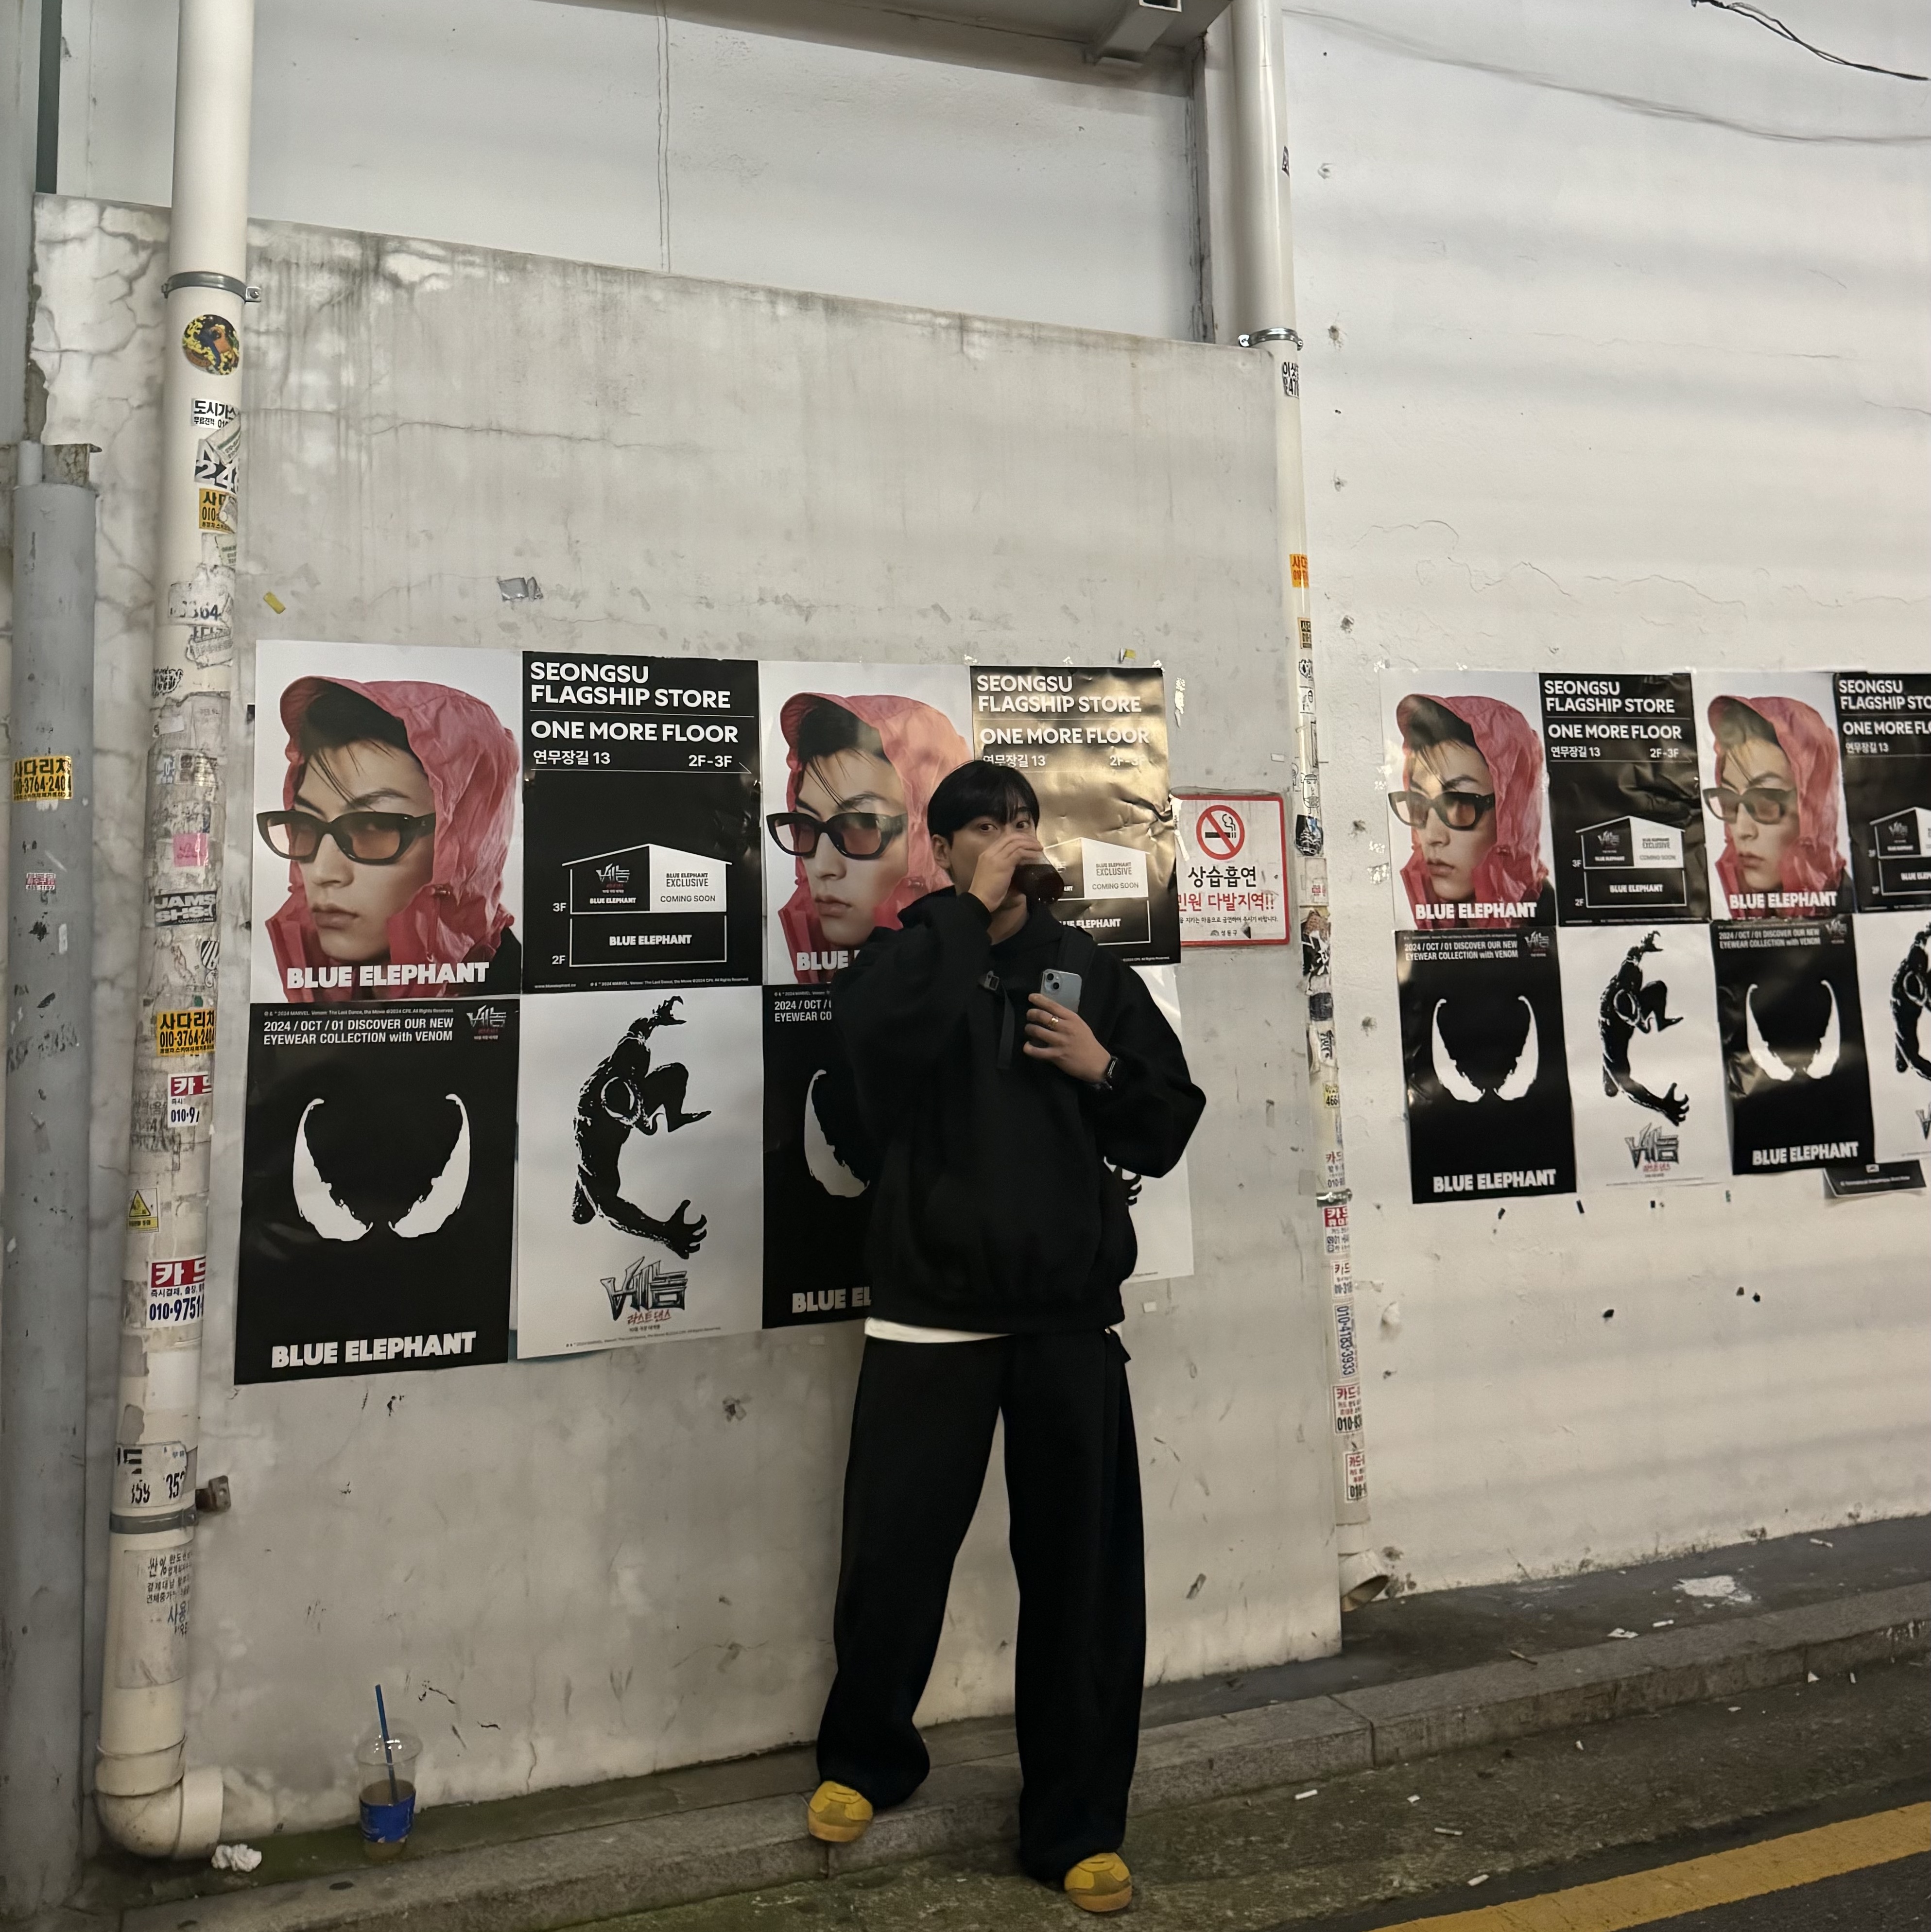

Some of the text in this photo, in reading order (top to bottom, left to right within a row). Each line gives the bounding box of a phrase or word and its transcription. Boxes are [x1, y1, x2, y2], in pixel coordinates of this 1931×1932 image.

[531, 662, 649, 683] SEONGSU
[977, 675, 1073, 692] SEONGSU
[1544, 680, 1620, 695] SEONGSU
[1839, 680, 1903, 694] SEONGSU
[531, 684, 731, 708] FLAGSHIP STORE
[978, 695, 1142, 712] FLAGSHIP STORE
[1840, 696, 1905, 710] FLAGSHIP
[1546, 698, 1675, 713] FLAGSHIP STORE
[531, 721, 738, 743] ONE MORE FLOOR
[1548, 724, 1682, 740] ONE MORE FLOOR
[1843, 721, 1873, 735] ONE
[1874, 721, 1914, 735] MORE
[980, 728, 1149, 744] ONE MORE FLOOR
[1551, 746, 1601, 758] 연무장길 13
[1650, 748, 1679, 758] 2F-3F
[1879, 742, 1889, 752] 13
[533, 750, 611, 765] 연무장길 13
[688, 755, 732, 767] 2F-3F
[1031, 755, 1045, 766] 13
[1096, 867, 1132, 876] EXCLUSIVE
[1188, 865, 1257, 888] 상습흡연
[666, 879, 708, 887] EXCLUSIVE
[1609, 884, 1663, 893] BLUE ELEPHANT
[155, 894, 216, 909] JAMS
[553, 903, 567, 912] 3F
[1208, 892, 1274, 912] 다발지역!!
[1729, 891, 1837, 909] BLUE ELEPHANT
[1415, 902, 1537, 919] BLUE ELEPHANT
[609, 934, 692, 946] BLUE ELEPHANT
[1405, 942, 1422, 951] 2024
[1427, 942, 1439, 950] OCT
[1445, 942, 1452, 950] 01
[1454, 941, 1485, 950] DISCOVER
[1487, 941, 1501, 949] OUR
[1503, 940, 1517, 949] NEW
[552, 956, 566, 965] 2F
[797, 950, 848, 971] BLUE
[1406, 952, 1436, 961] EYEWEAR
[1438, 951, 1478, 960] COLLECTION
[1495, 949, 1518, 958] VENOM
[287, 962, 489, 988] BLUE ELEPHANT
[775, 1001, 796, 1010] 2024
[804, 1000, 821, 1009] OCT
[264, 1018, 454, 1031] 2024 / OCT / 01 DISCOVER OUR NEW
[775, 1012, 817, 1022] EYEWEAR
[264, 1031, 452, 1045] EYEWEAR COLLECTION with VENOM
[1752, 1141, 1859, 1165] BLUE ELEPHANT
[1433, 1169, 1556, 1192] BLUE ELEPHANT
[792, 1288, 846, 1313] BLUE
[272, 1331, 476, 1368] BLUE ELEPHANT
